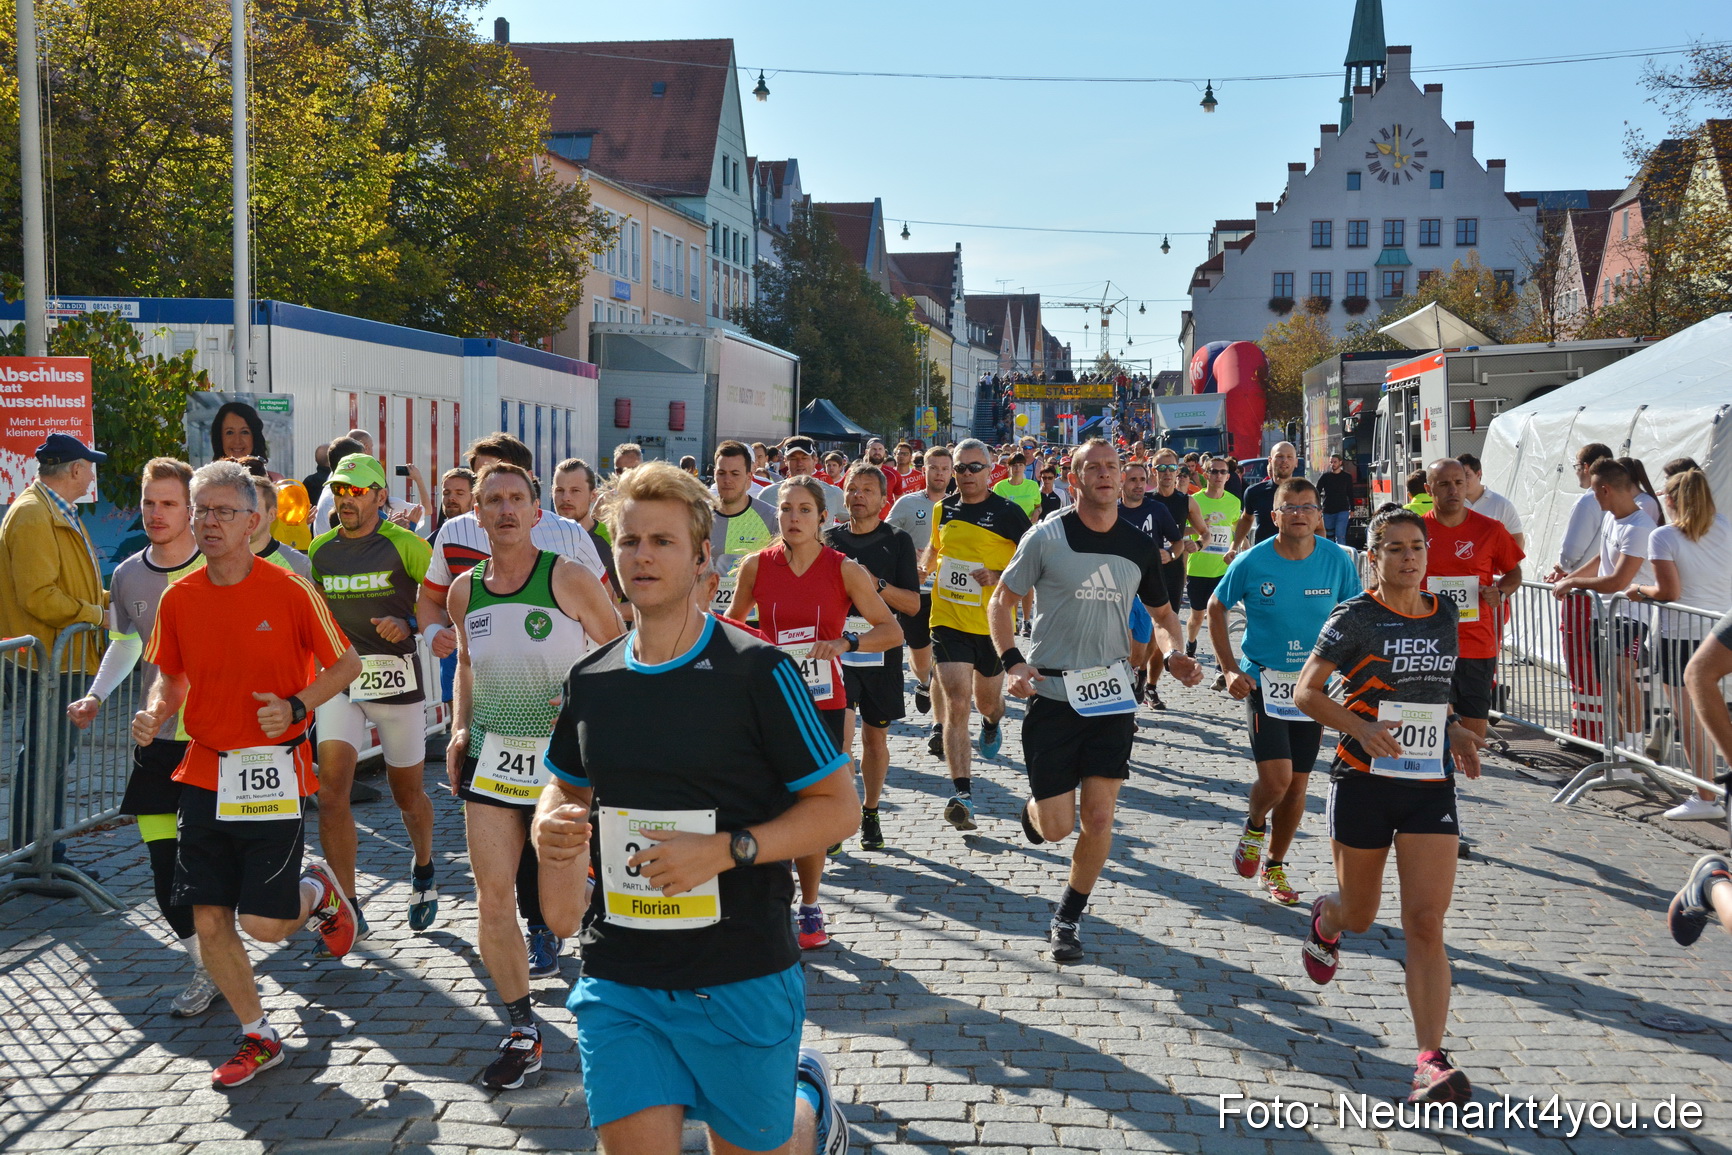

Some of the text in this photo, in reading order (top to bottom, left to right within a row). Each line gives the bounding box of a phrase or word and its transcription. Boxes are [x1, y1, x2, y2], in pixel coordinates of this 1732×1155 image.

[1046, 387, 1080, 396] START
[10, 417, 83, 426] Mehr Lehrer für
[6, 428, 45, 437] kleinere
[1211, 533, 1228, 543] 172
[322, 572, 392, 592] BOCK
[950, 571, 967, 586] 86
[367, 589, 396, 598] concepts
[715, 589, 735, 604] 22
[950, 592, 965, 600] Peter
[1075, 587, 1122, 603] adidas
[1304, 588, 1331, 596] BOCK
[787, 630, 805, 639] DEHN
[1287, 640, 1303, 651] 18.
[1383, 639, 1440, 655] HECK
[360, 670, 406, 690] 2526
[1082, 668, 1108, 680] BOCK
[810, 685, 826, 695] phie
[1076, 678, 1121, 702] 3036
[1401, 709, 1433, 719] BOCK
[1388, 724, 1437, 748] 2018
[503, 737, 536, 749] BOCK
[241, 753, 274, 763] BOCK
[496, 750, 536, 776] 241
[238, 767, 281, 791] 158
[492, 772, 532, 784] PARTL Neumarkt
[494, 782, 530, 797] Markus
[240, 804, 279, 814] Thomas
[628, 819, 677, 831] BOCK
[622, 882, 644, 891] PARTL
[632, 899, 681, 915] Florian
